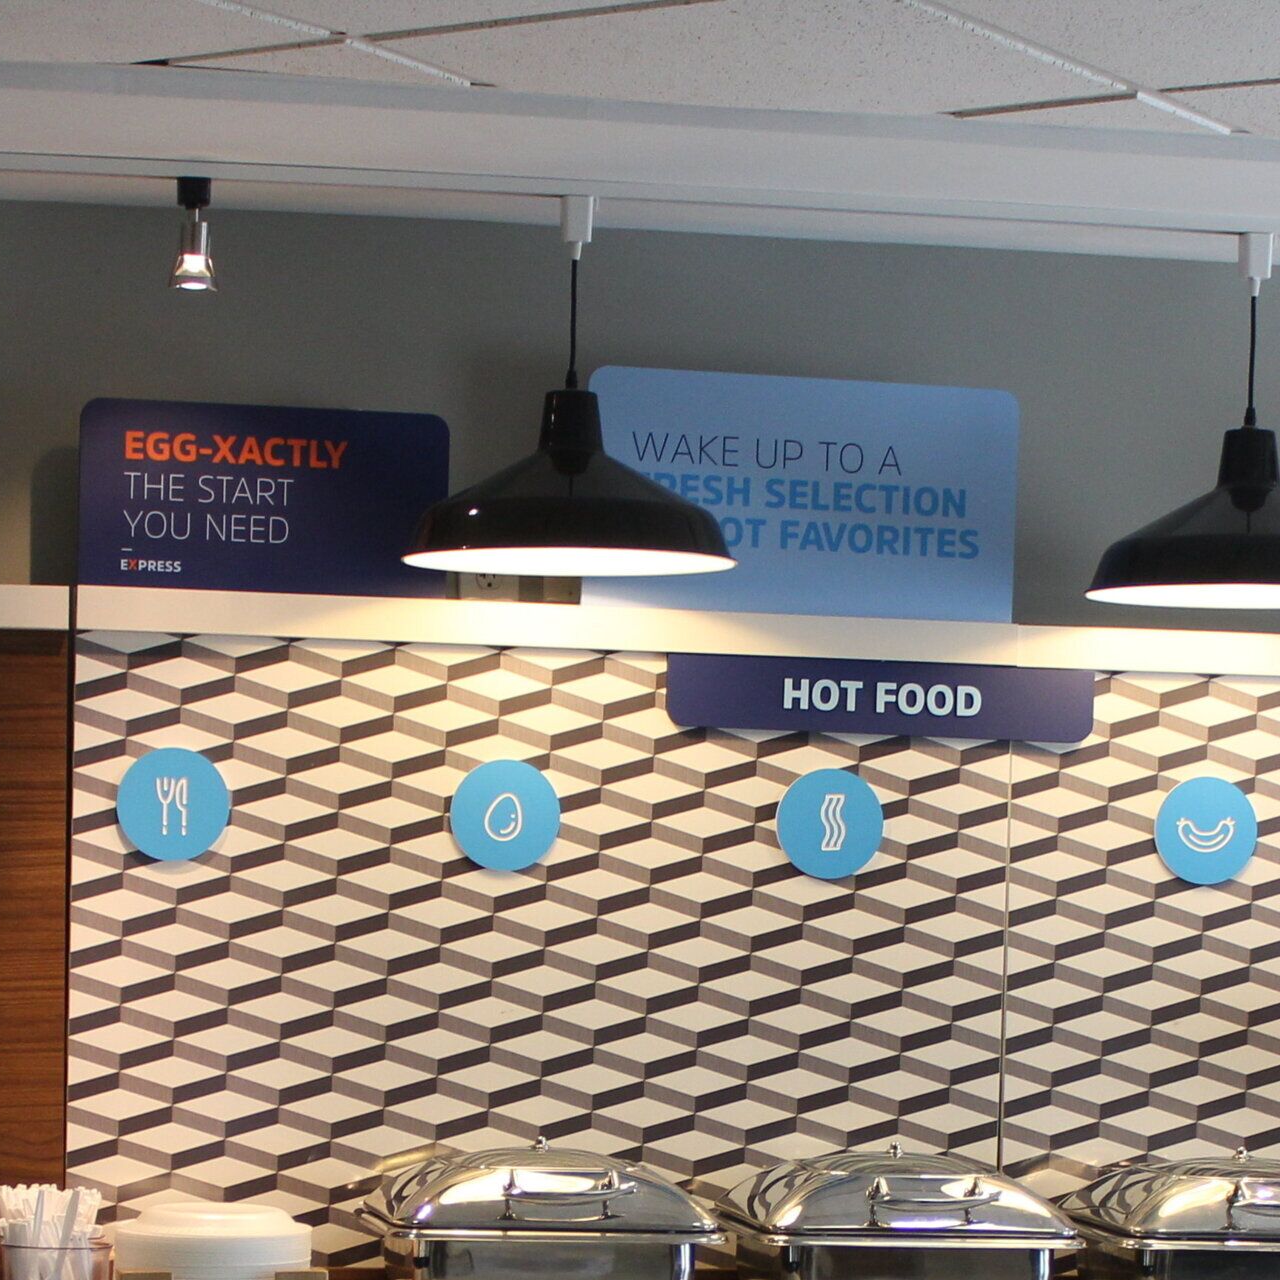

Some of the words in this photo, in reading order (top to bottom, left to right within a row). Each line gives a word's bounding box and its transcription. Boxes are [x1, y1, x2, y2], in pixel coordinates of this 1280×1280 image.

[124, 430, 349, 470] EGG-XACTLY
[632, 430, 740, 468] WAKE
[754, 437, 804, 471] UP
[819, 441, 865, 475] TO
[878, 445, 903, 477] A
[123, 471, 185, 502] THE
[198, 475, 295, 507] START
[765, 477, 967, 519] SELECTION
[123, 509, 192, 540] YOU
[206, 513, 290, 544] NEED
[779, 519, 980, 560] FAVORITES
[120, 558, 182, 573] EXPRESS
[782, 677, 864, 714] HOT
[875, 681, 983, 718] FOOD
